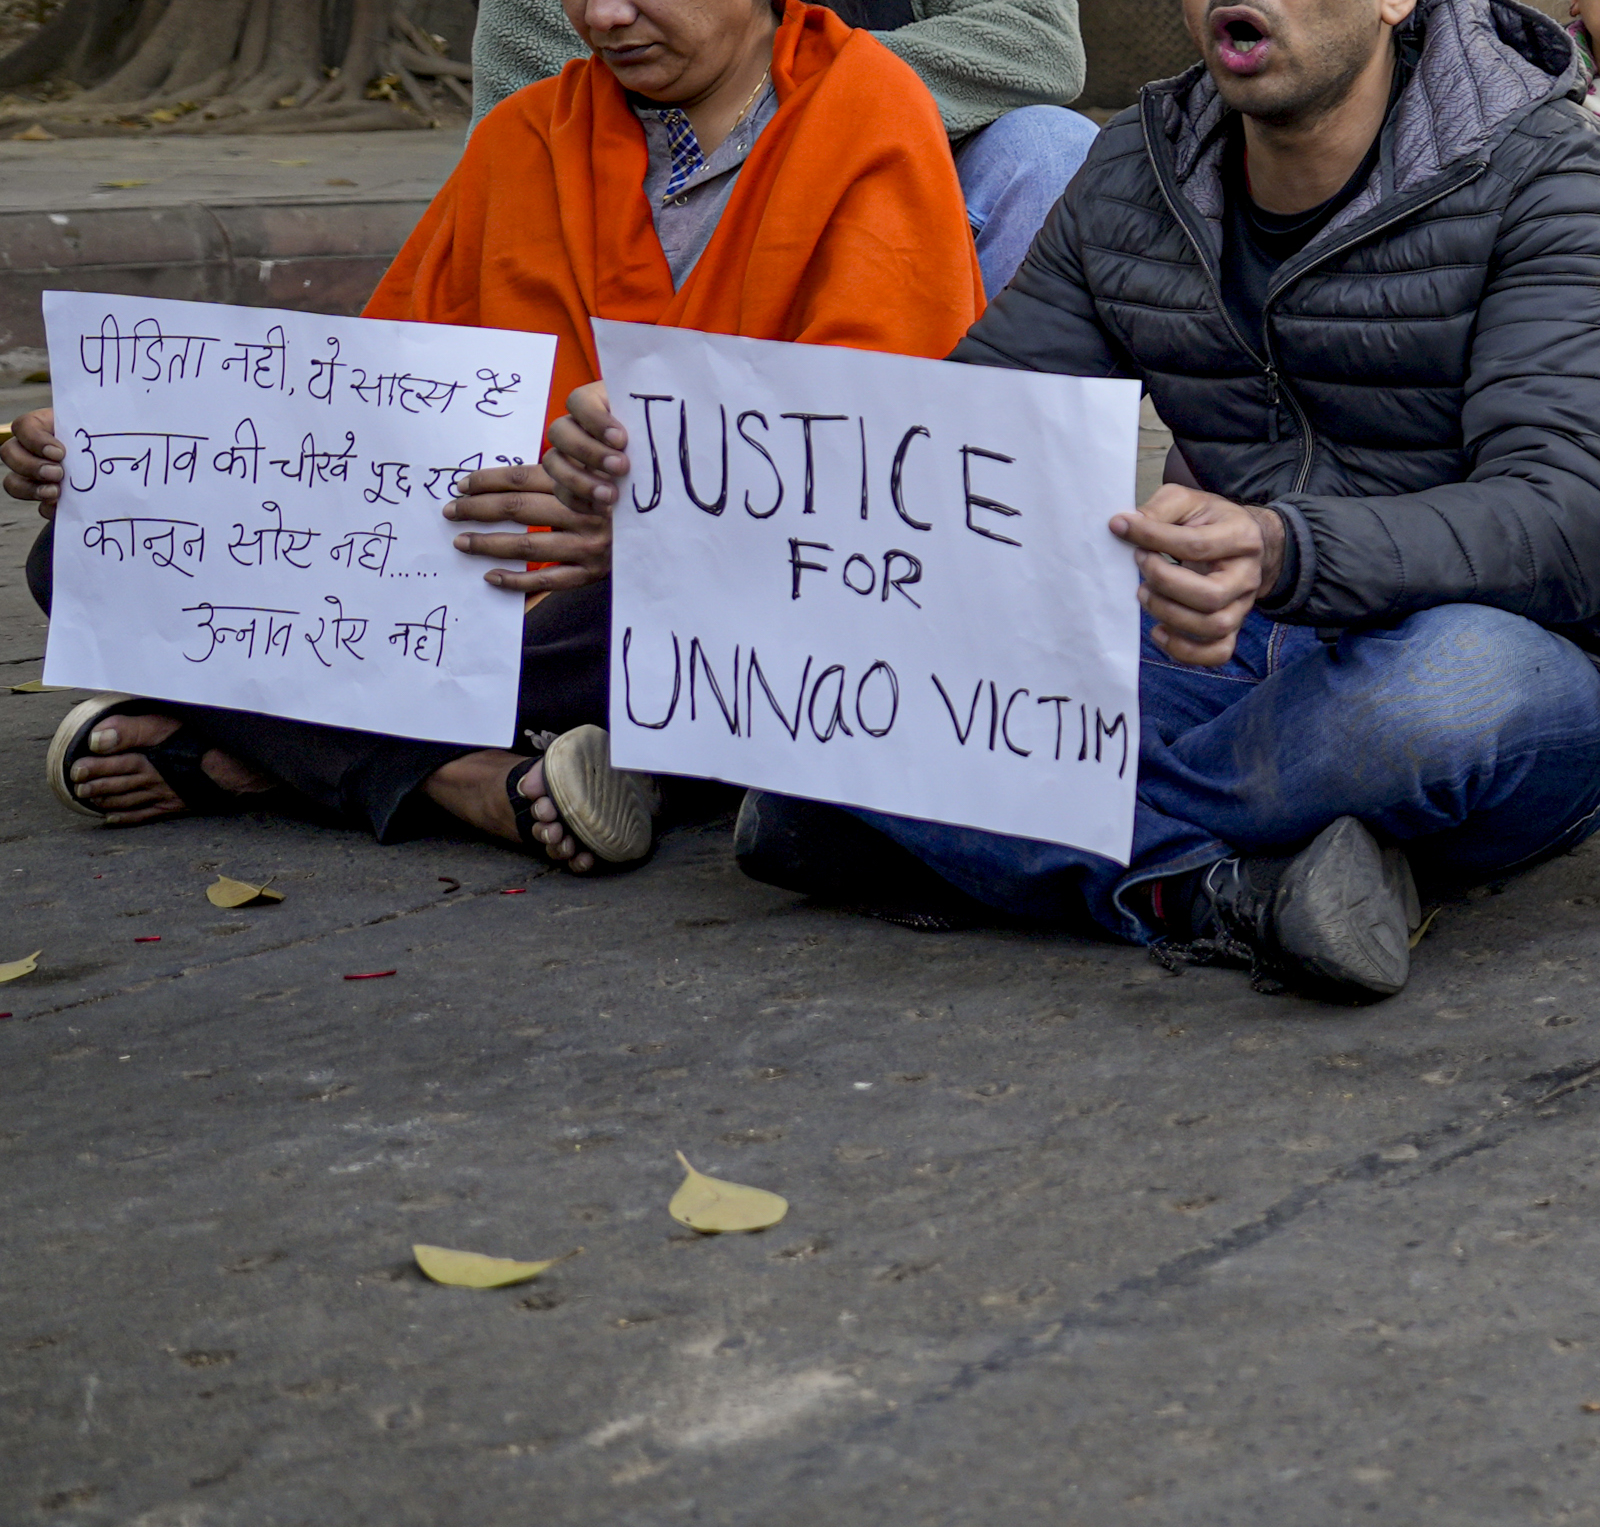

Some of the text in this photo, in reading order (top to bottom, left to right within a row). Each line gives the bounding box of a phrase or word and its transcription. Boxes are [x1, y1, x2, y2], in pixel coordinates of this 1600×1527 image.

[80, 313, 221, 393] पीड़िता
[307, 335, 348, 405] ये
[350, 368, 468, 414] साहस
[475, 367, 522, 417] है
[69, 427, 209, 493] उन्नाव
[212, 417, 266, 484] की
[629, 392, 1023, 548] JUSTICE
[83, 517, 205, 578] कानून
[787, 536, 923, 609] FOR
[931, 672, 1129, 780] VICTIM
